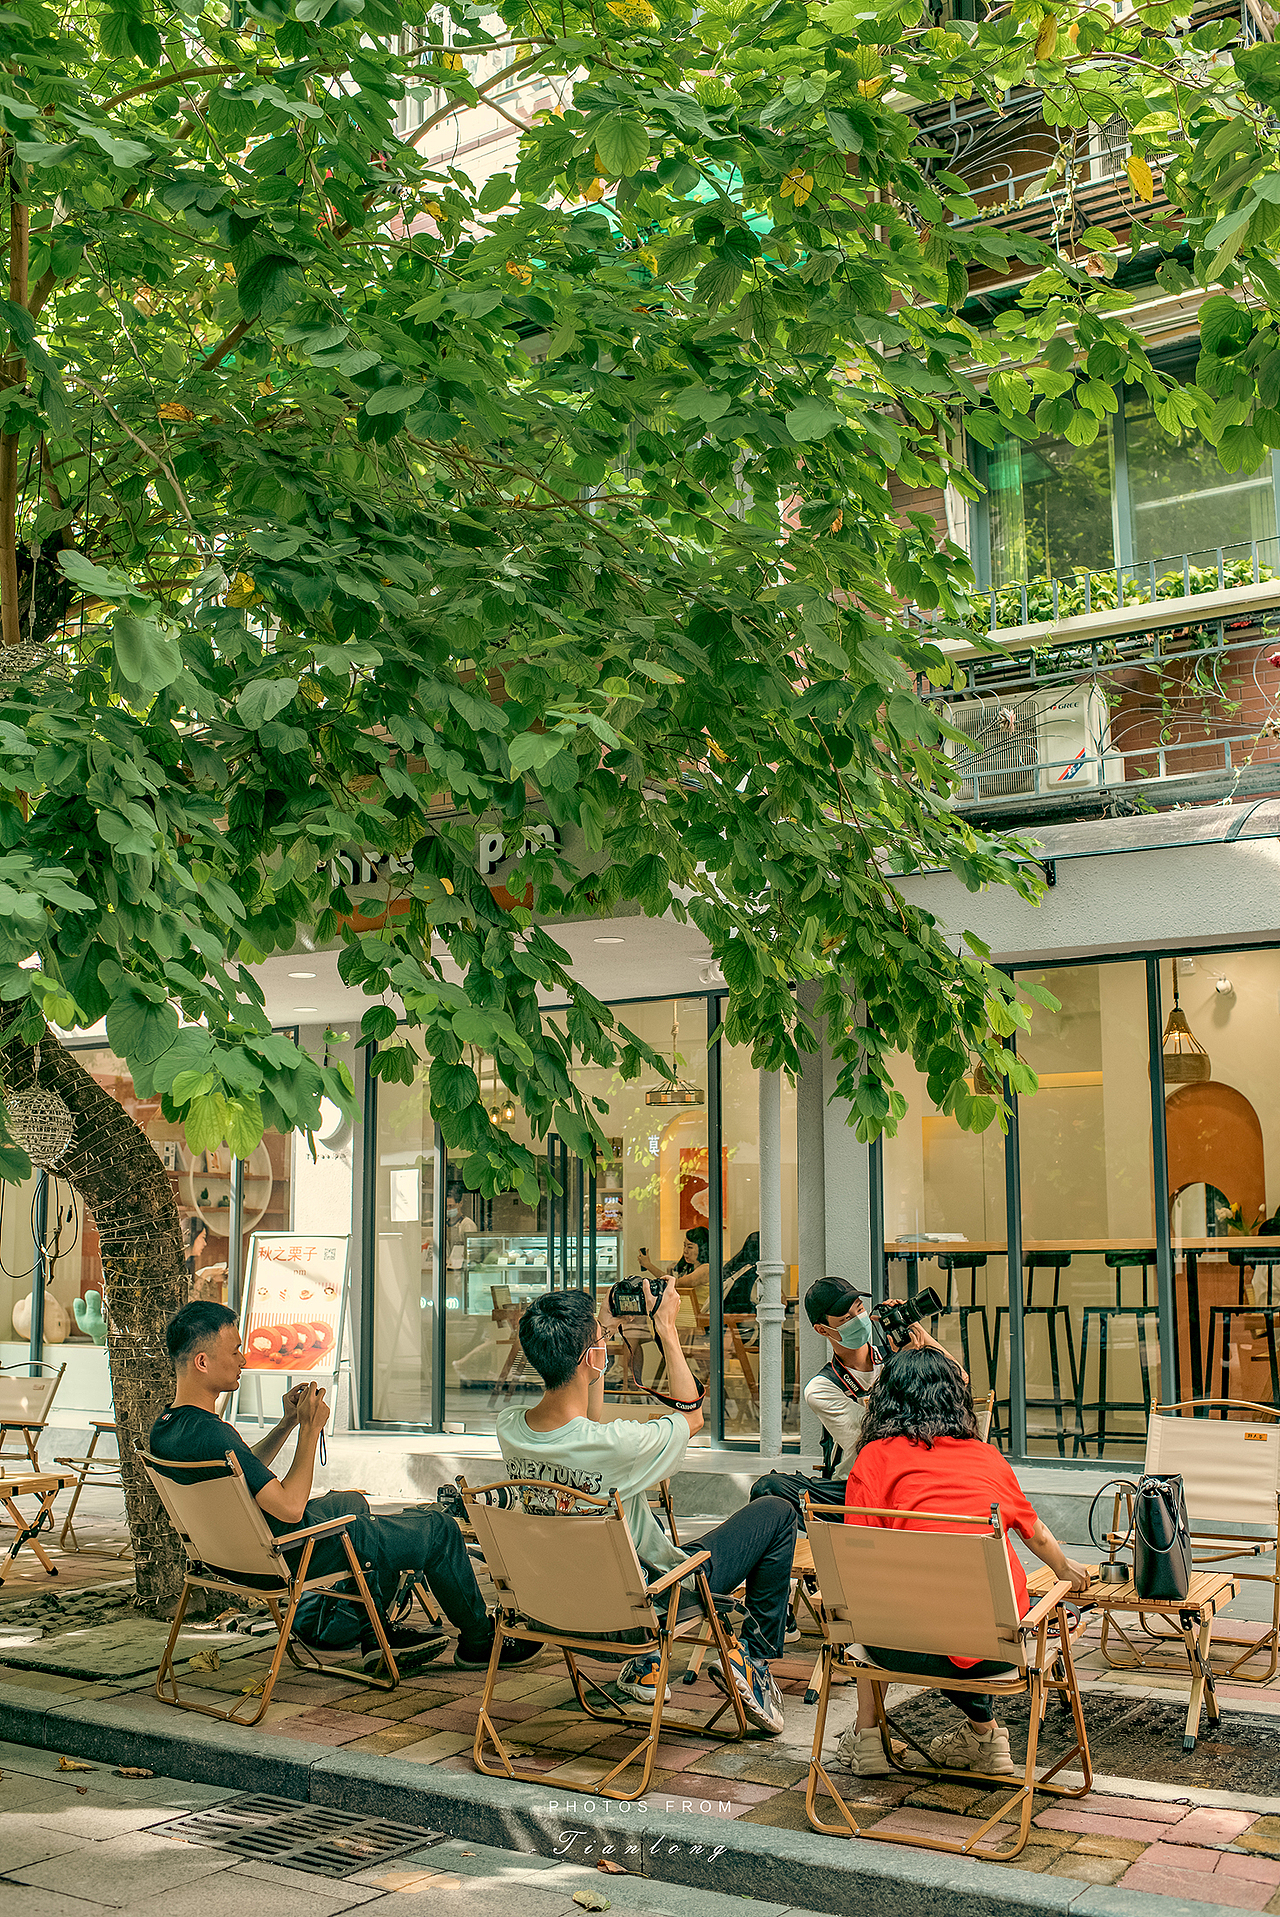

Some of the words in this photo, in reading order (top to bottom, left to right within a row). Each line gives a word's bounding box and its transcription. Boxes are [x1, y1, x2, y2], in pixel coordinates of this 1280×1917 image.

[257, 1246, 318, 1262] 秋之栗子
[843, 1373, 859, 1392] Canon
[675, 1401, 697, 1410] Canon
[545, 1462, 603, 1495] TUNES
